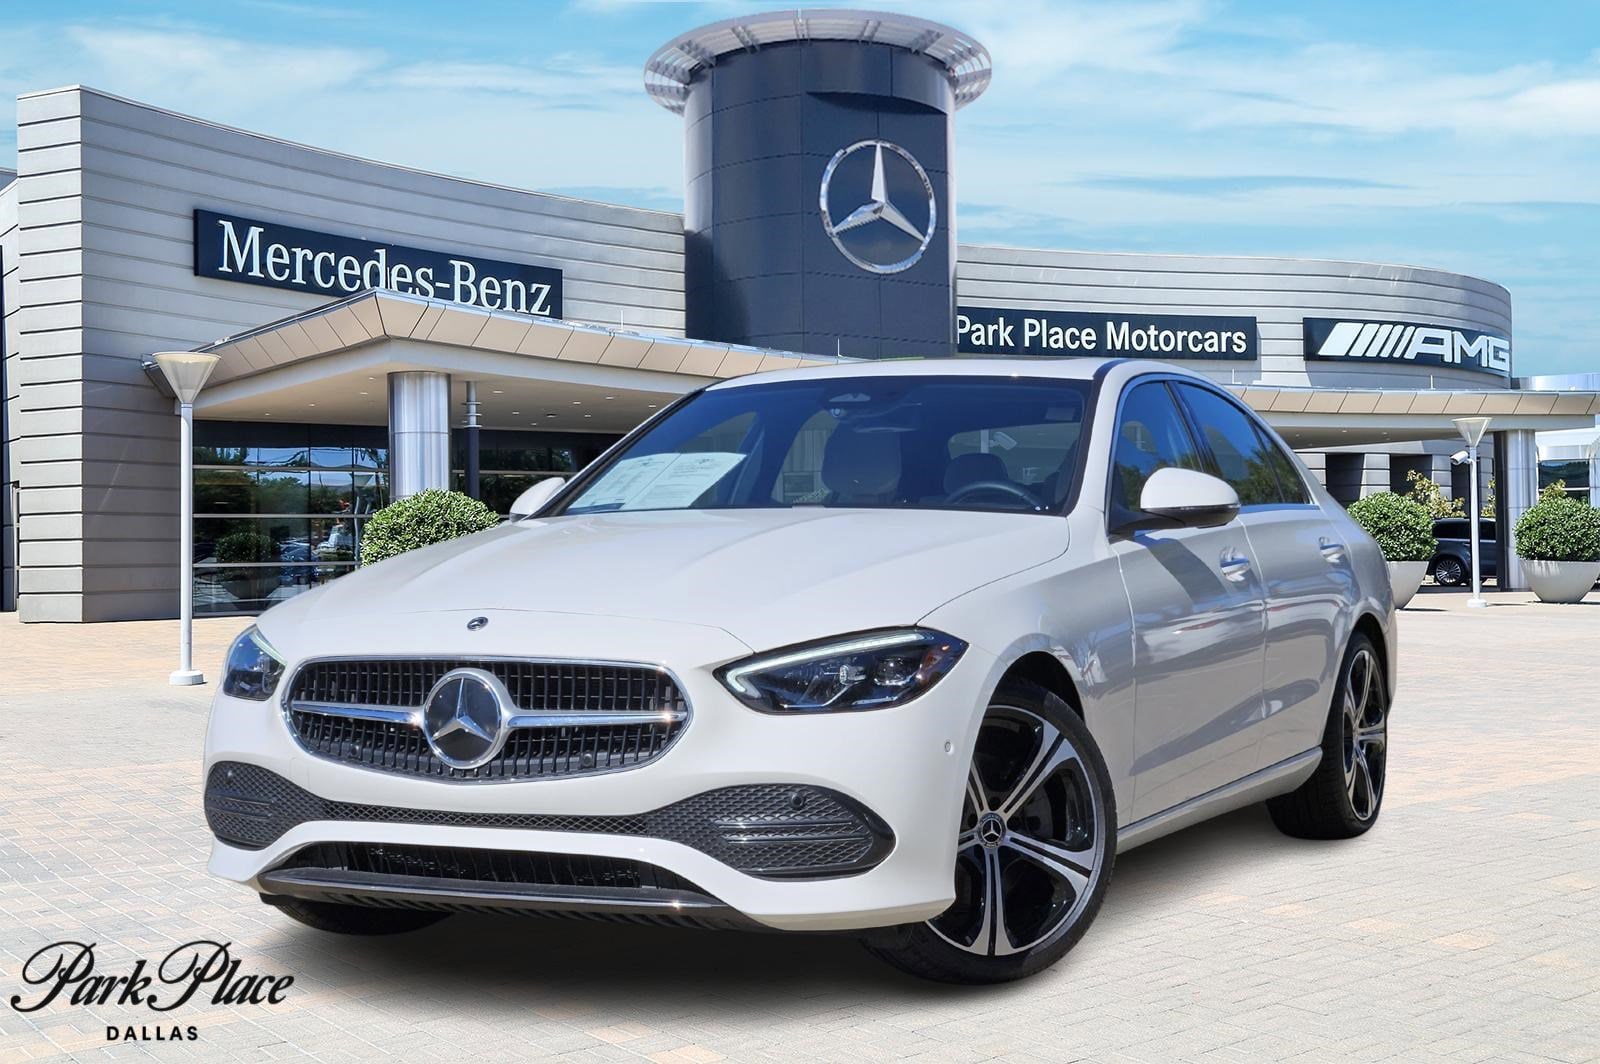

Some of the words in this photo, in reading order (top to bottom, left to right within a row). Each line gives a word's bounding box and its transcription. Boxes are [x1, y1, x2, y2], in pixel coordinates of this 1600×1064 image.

[218, 220, 552, 315] Mercedes-Benz
[957, 315, 1015, 347] Park
[1025, 319, 1097, 351] Place
[1106, 321, 1247, 354] Motorcars
